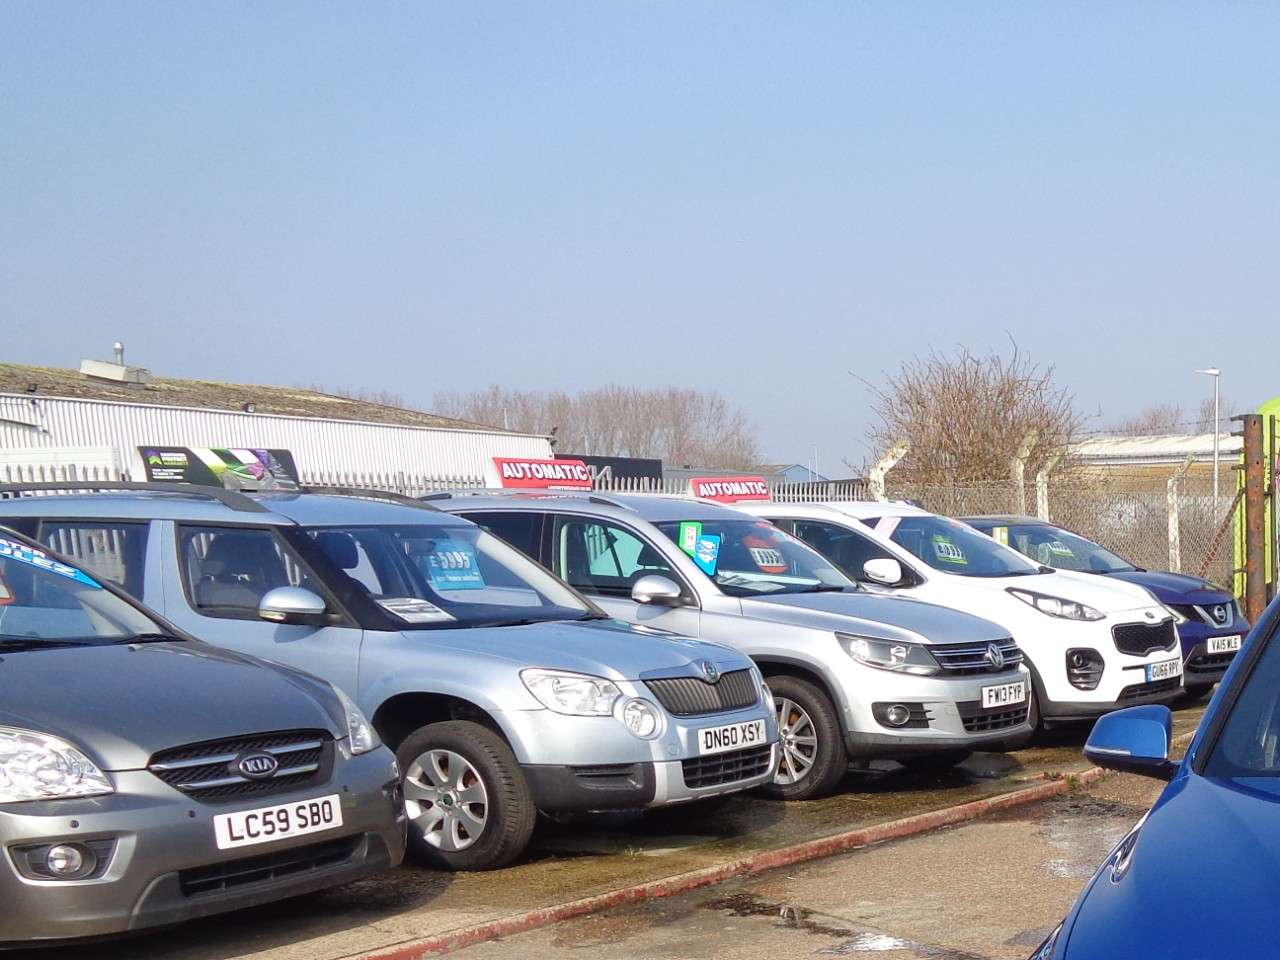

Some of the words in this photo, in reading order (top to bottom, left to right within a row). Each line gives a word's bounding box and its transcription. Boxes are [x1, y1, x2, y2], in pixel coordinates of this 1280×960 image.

[501, 461, 589, 482] AUTOMATIC
[698, 480, 768, 499] AUTOMATIC
[988, 687, 1007, 704] FW13
[704, 727, 738, 750] DN60
[740, 722, 761, 743] XSY
[245, 757, 273, 772] KIA
[227, 808, 290, 842] LC59
